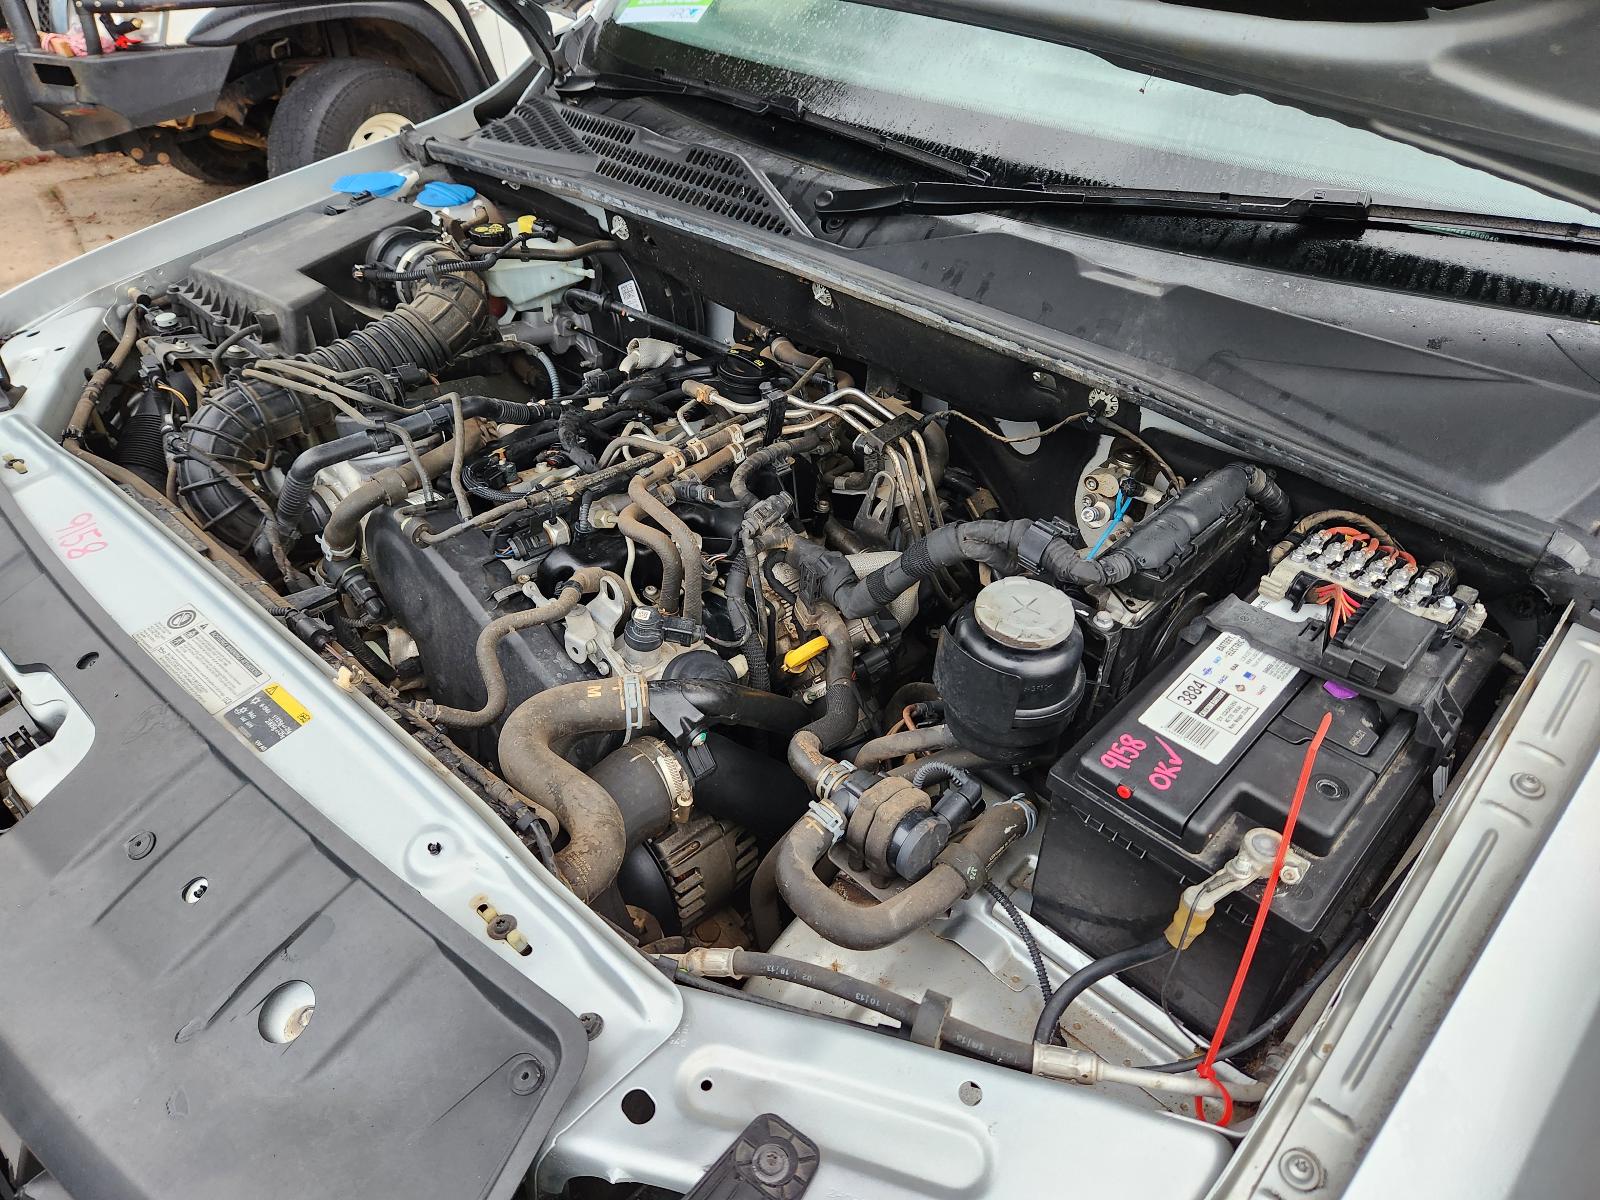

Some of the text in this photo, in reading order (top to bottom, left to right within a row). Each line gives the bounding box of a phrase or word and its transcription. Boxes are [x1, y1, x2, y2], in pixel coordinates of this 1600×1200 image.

[56, 512, 108, 560] 9158
[1177, 680, 1207, 706] 3884
[1101, 733, 1147, 769] 9158
[1148, 760, 1182, 790] OK
